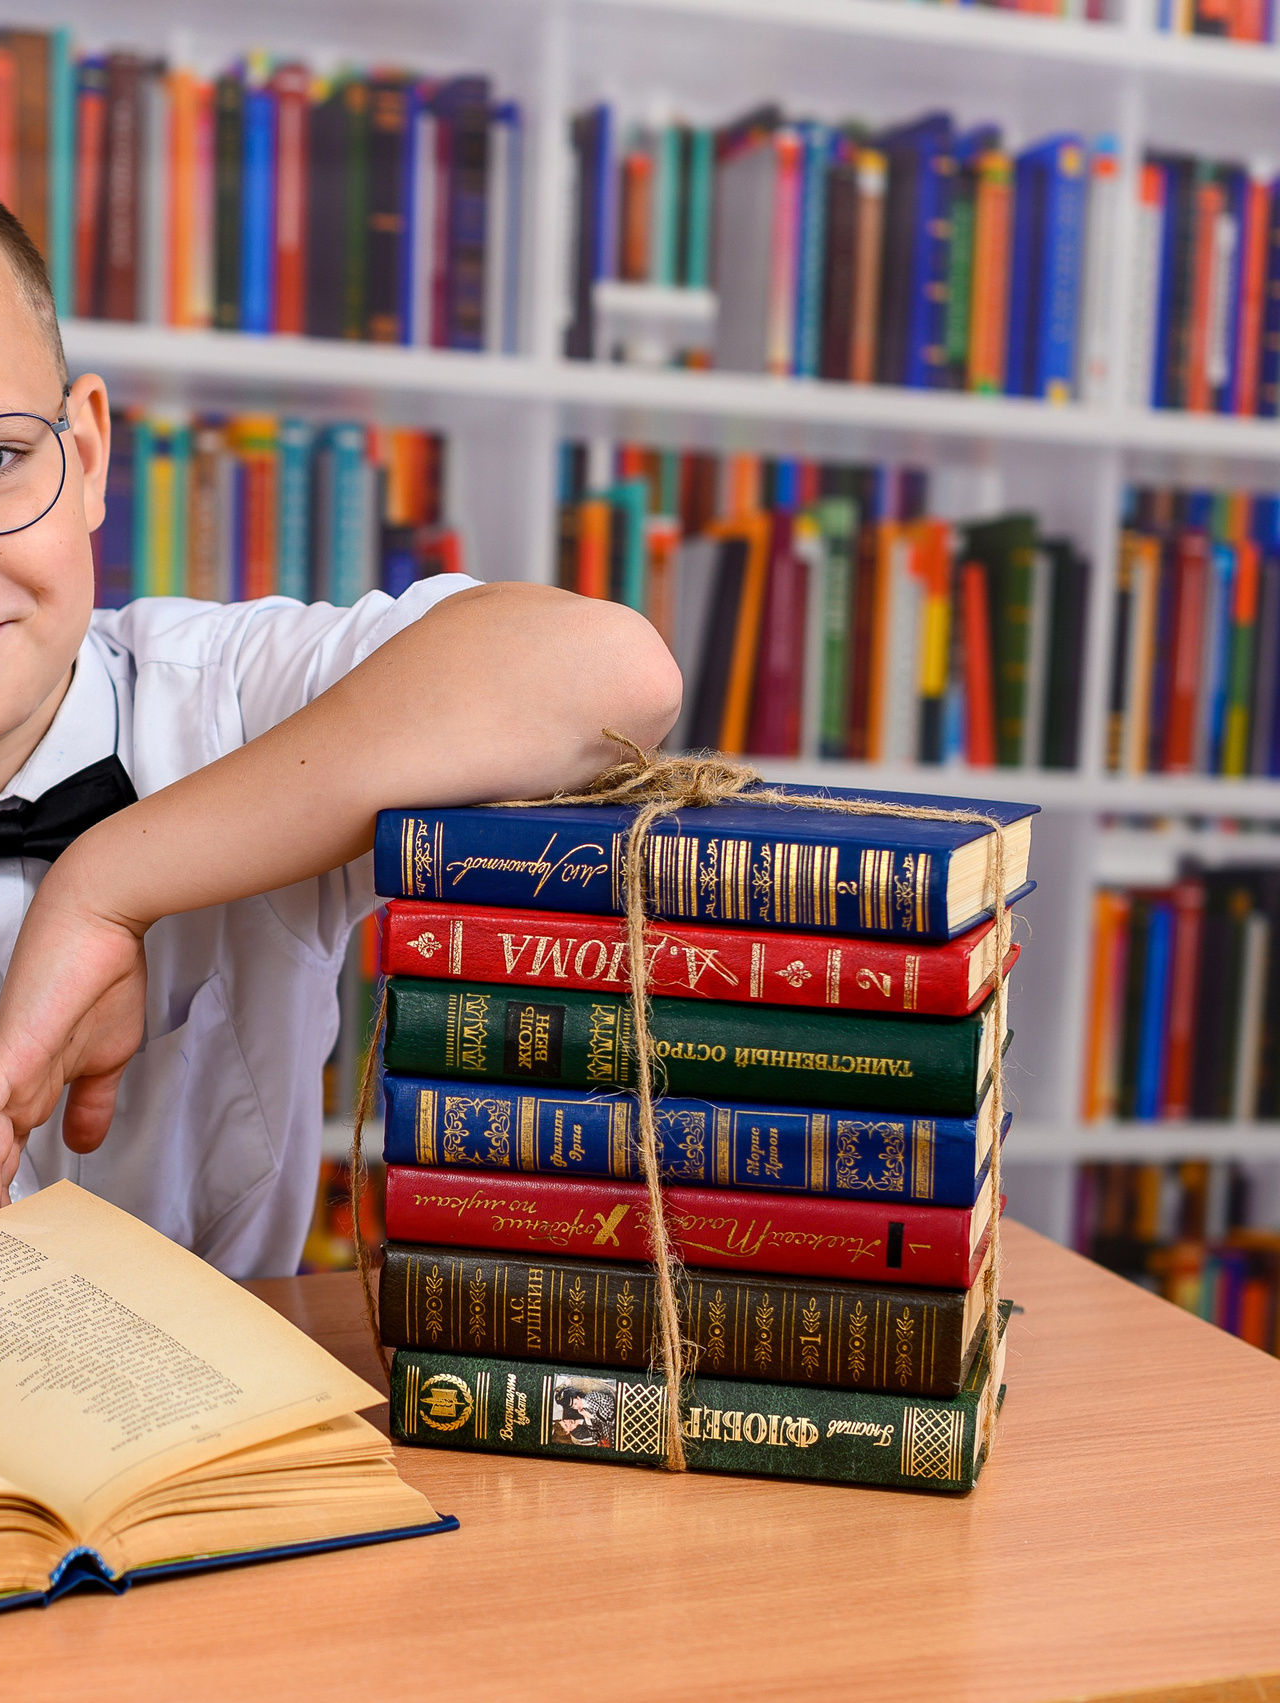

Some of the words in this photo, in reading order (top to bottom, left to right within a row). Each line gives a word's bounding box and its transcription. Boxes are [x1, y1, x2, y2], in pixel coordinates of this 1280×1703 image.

[445, 832, 605, 898] Лермонтов
[837, 880, 859, 895] 2
[855, 967, 893, 997] 2
[518, 1006, 535, 1070] ЖЮЛЬ
[535, 1013, 551, 1062] ВЕРН
[649, 1039, 726, 1062] ОСТРО
[734, 1045, 914, 1078] ТАИНСТВЕННЫЙ
[549, 1108, 569, 1168] Филипп
[569, 1124, 586, 1162] Эриа
[747, 1126, 766, 1176] Морис
[765, 1127, 783, 1179] Дрюон
[412, 1189, 506, 1218] мукам
[491, 1203, 630, 1246] Хождение
[635, 1209, 772, 1258] Толсй
[768, 1229, 883, 1263] Алексей
[509, 1296, 525, 1324] А.С.
[499, 1372, 517, 1441] Воспитание
[681, 1406, 819, 1448] ФЛОБЕР
[825, 1418, 895, 1447] Гюстав
